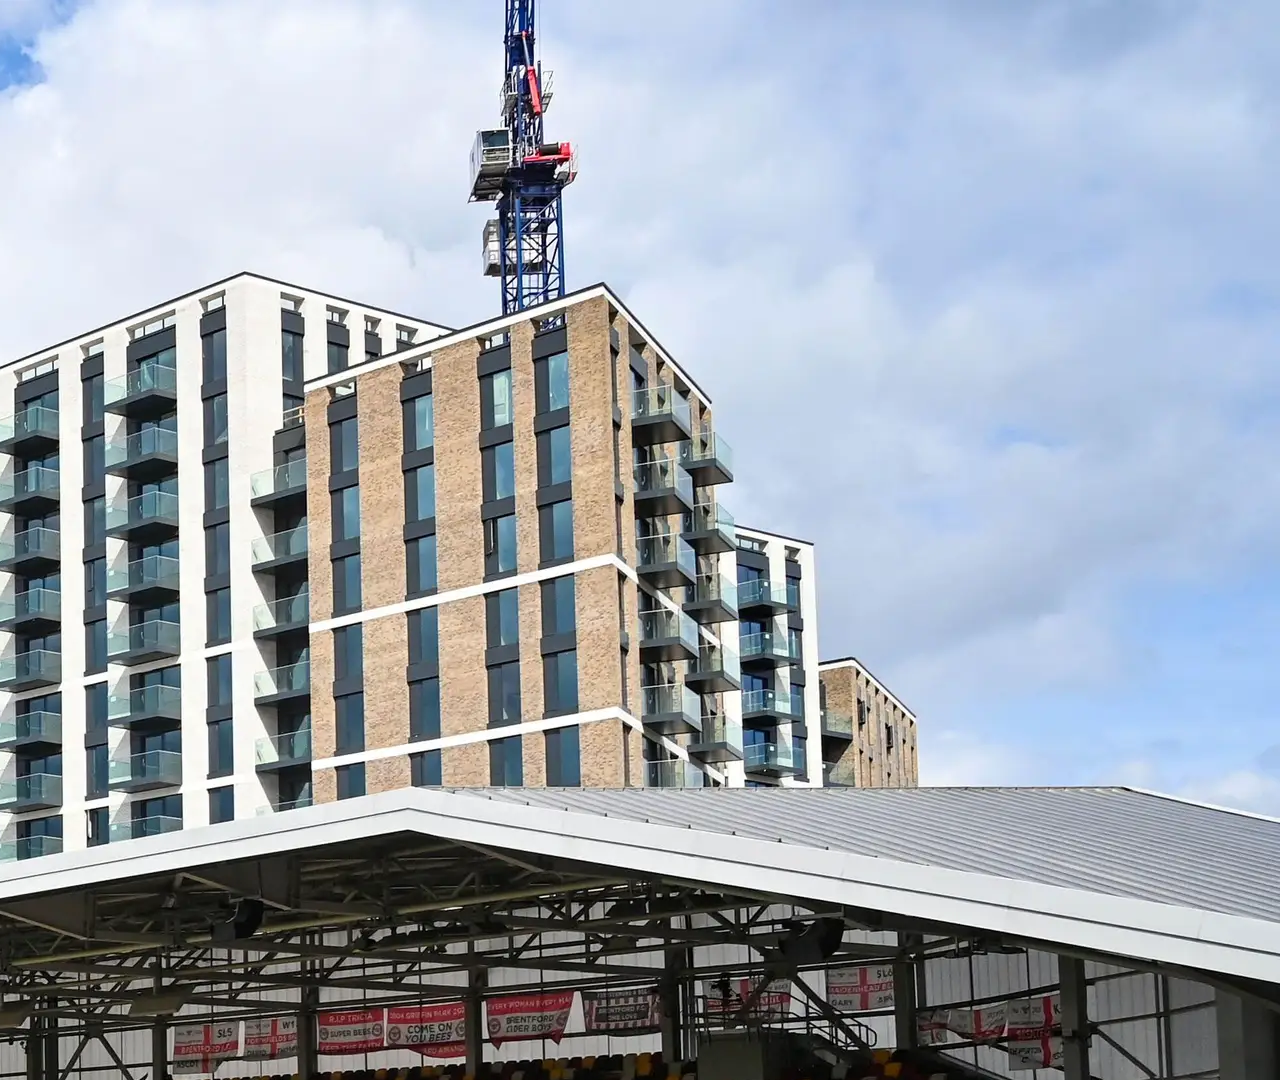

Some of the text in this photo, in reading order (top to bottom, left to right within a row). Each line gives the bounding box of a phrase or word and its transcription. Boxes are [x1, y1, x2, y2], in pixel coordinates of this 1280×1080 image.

[506, 1014, 554, 1024] BRENTFORD
[407, 1022, 452, 1034] COME ON
[405, 1032, 452, 1043] YOU BEES
